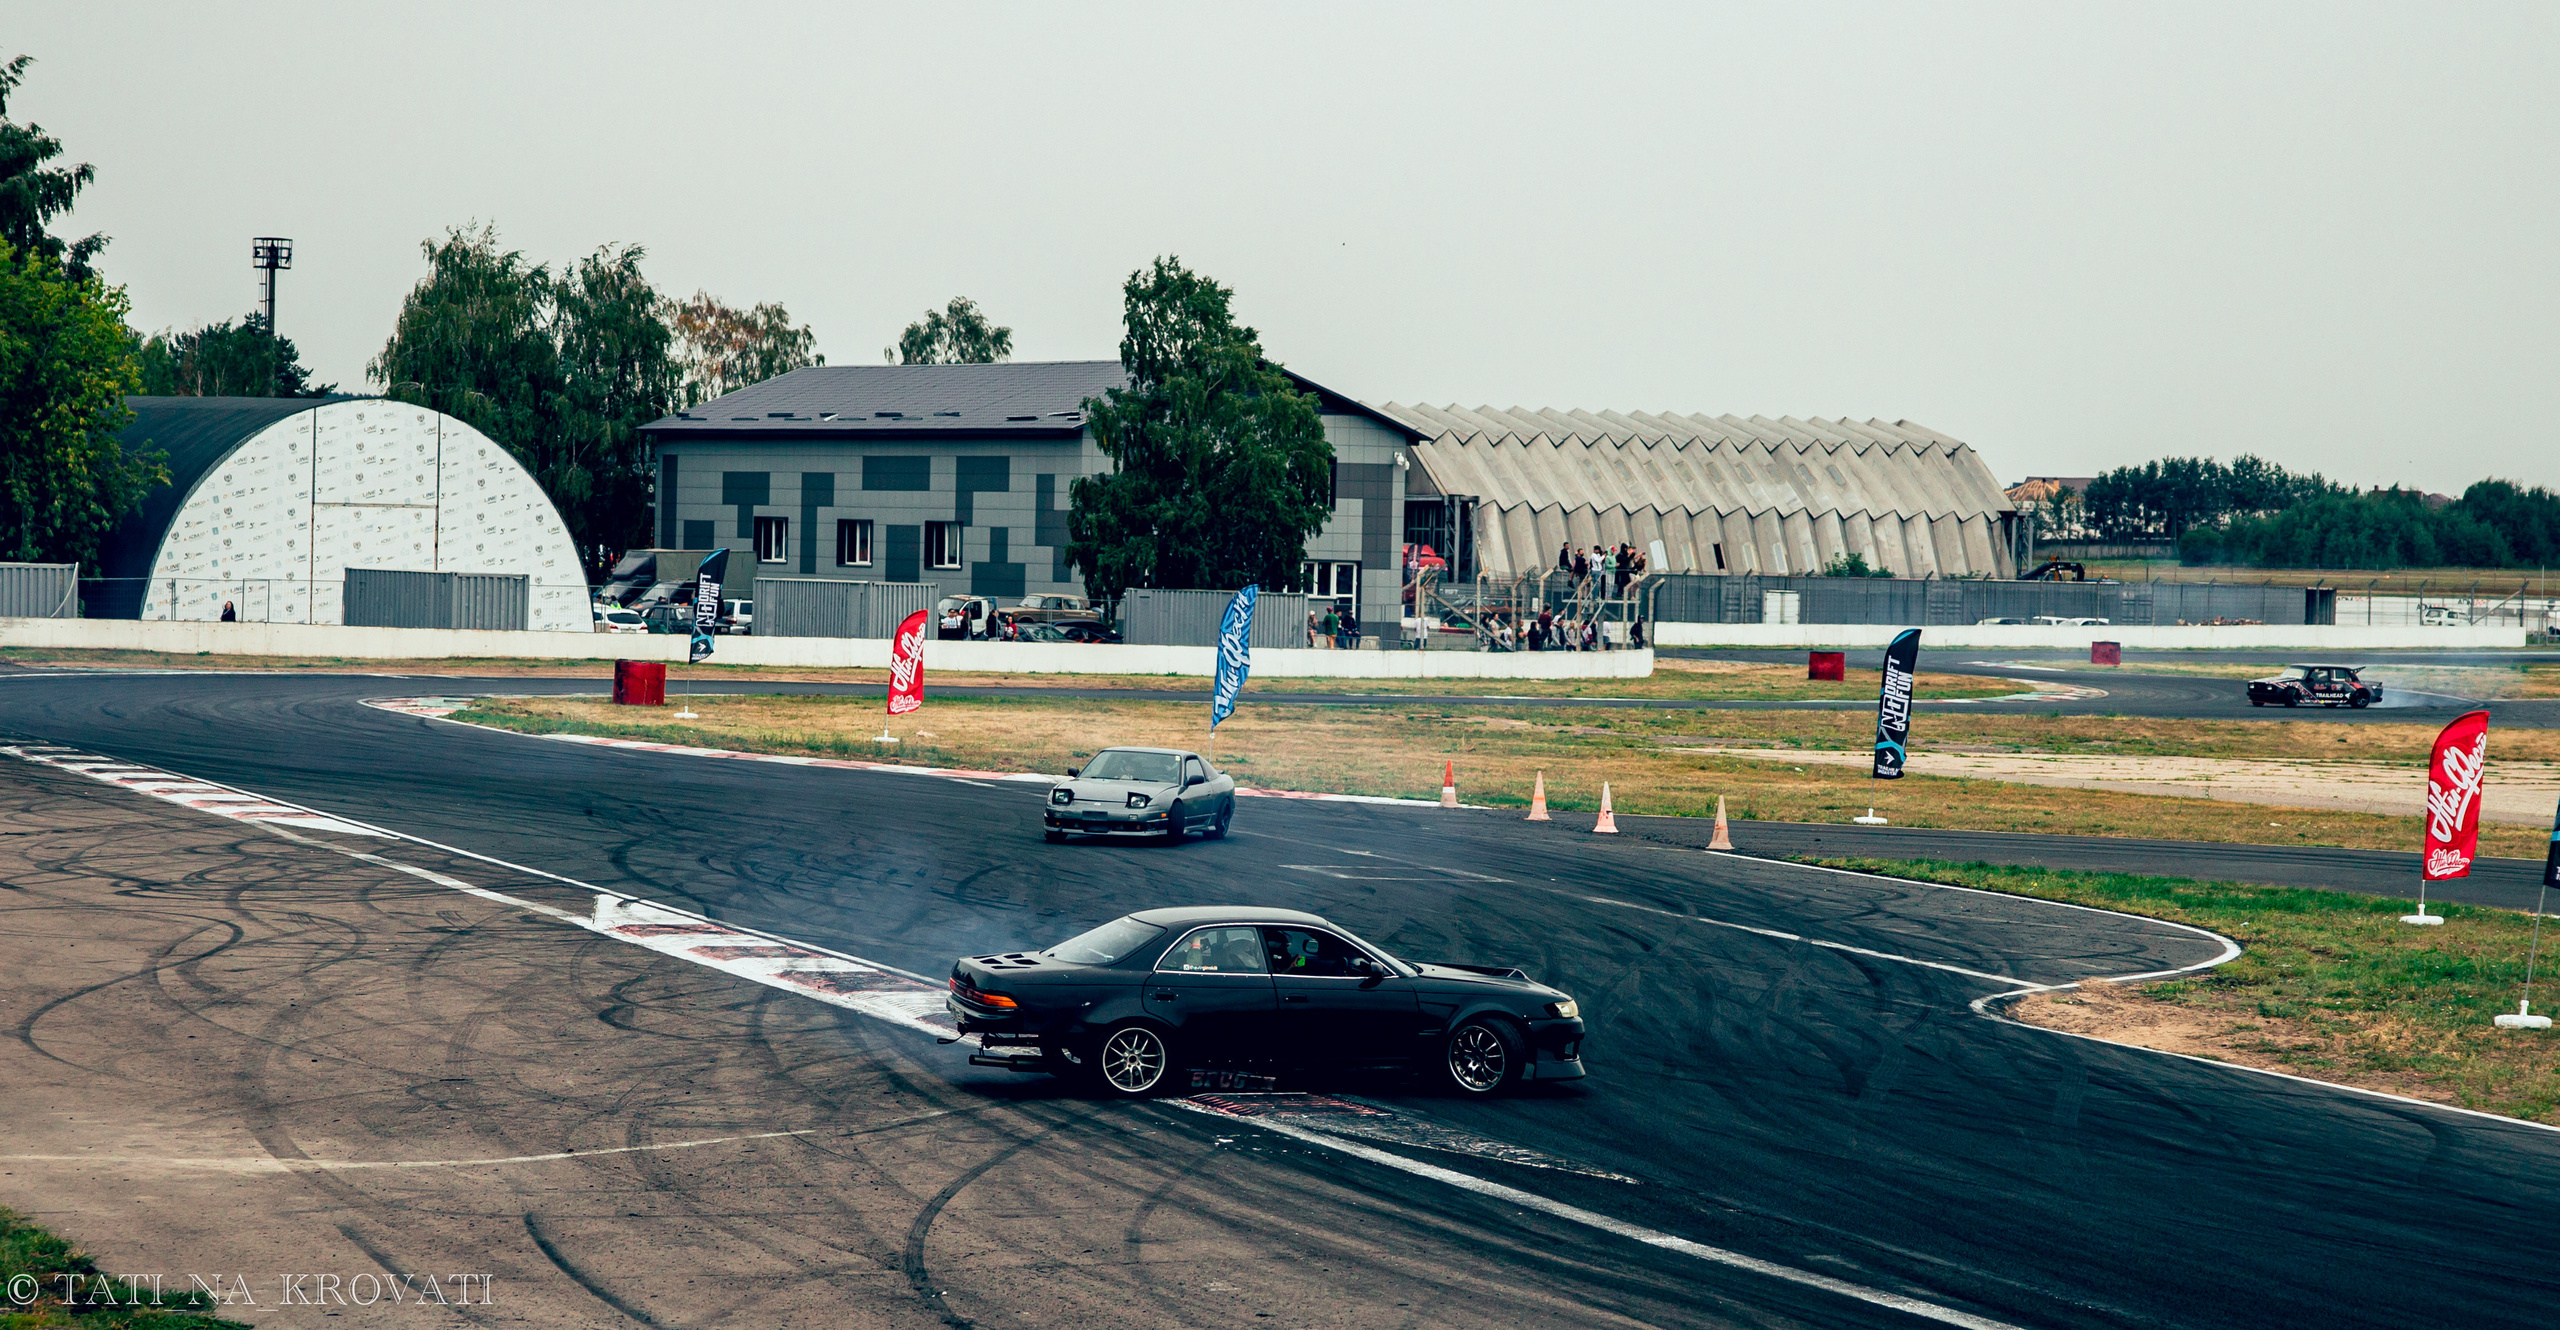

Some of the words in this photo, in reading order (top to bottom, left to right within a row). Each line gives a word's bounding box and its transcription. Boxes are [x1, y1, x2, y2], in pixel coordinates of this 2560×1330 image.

[699, 573, 711, 602] DRIFT
[710, 583, 720, 602] FUN
[1885, 655, 1900, 695] DRIFT
[1896, 671, 1913, 699] FUN
